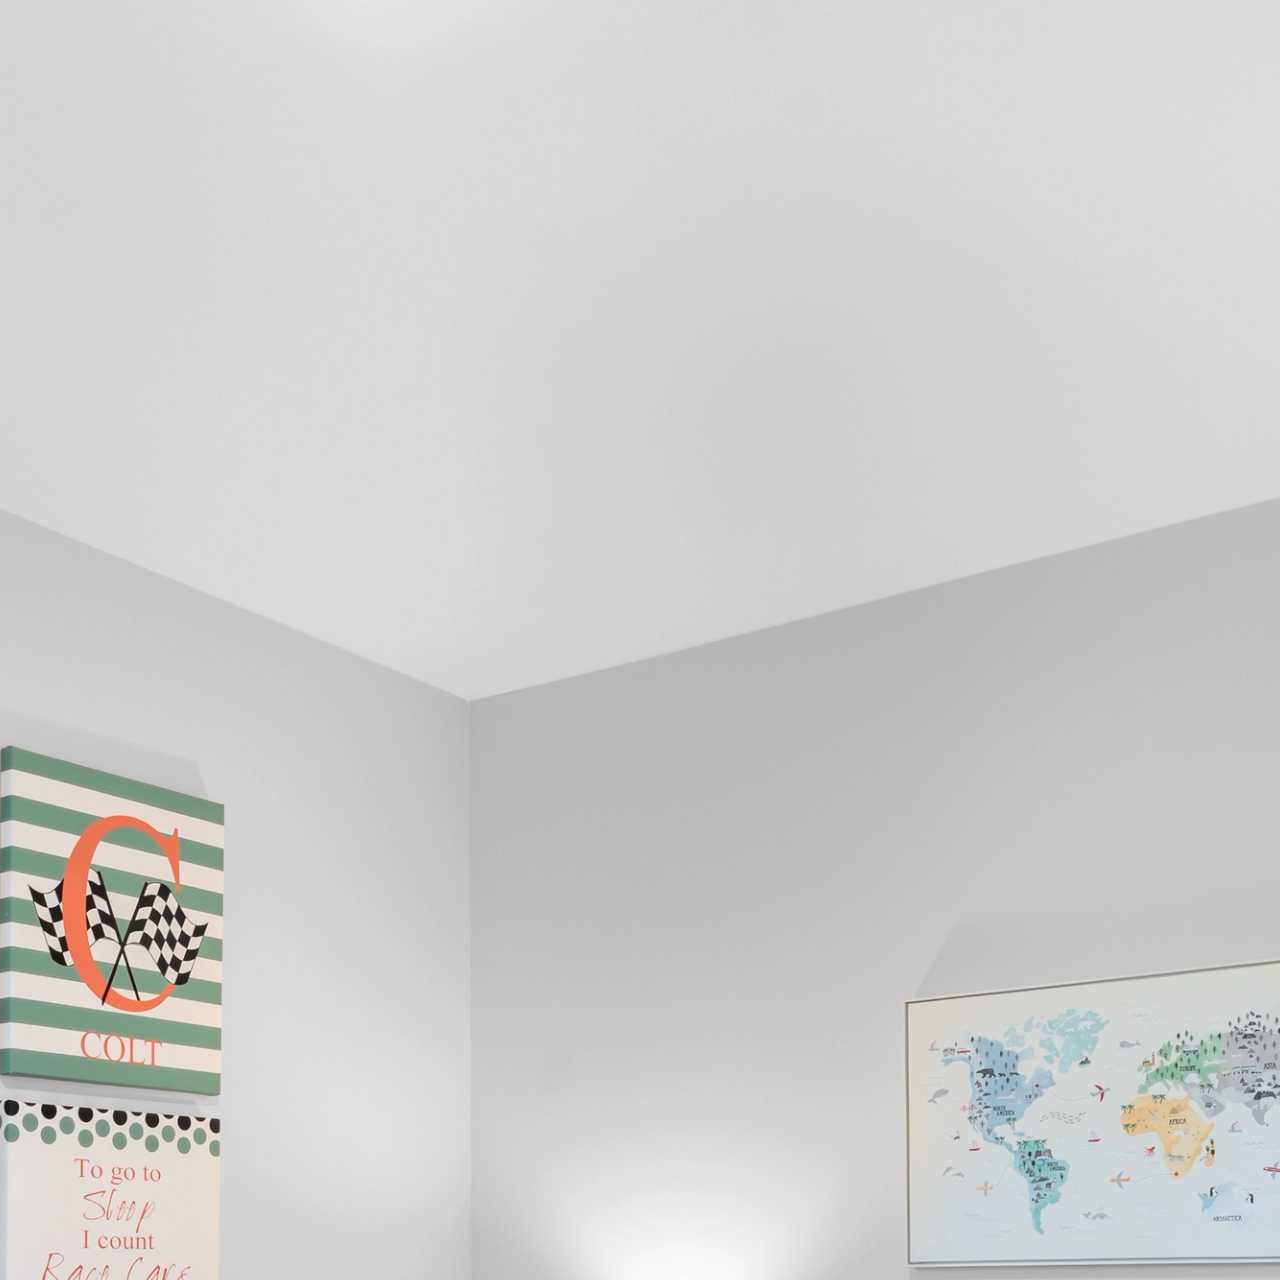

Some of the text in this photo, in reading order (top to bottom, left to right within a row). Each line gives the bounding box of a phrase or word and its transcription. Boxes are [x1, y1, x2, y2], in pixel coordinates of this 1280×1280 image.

[62, 815, 180, 1012] C
[80, 1031, 163, 1066] COLT
[74, 1158, 161, 1185] To go to
[83, 1230, 156, 1250] I count
